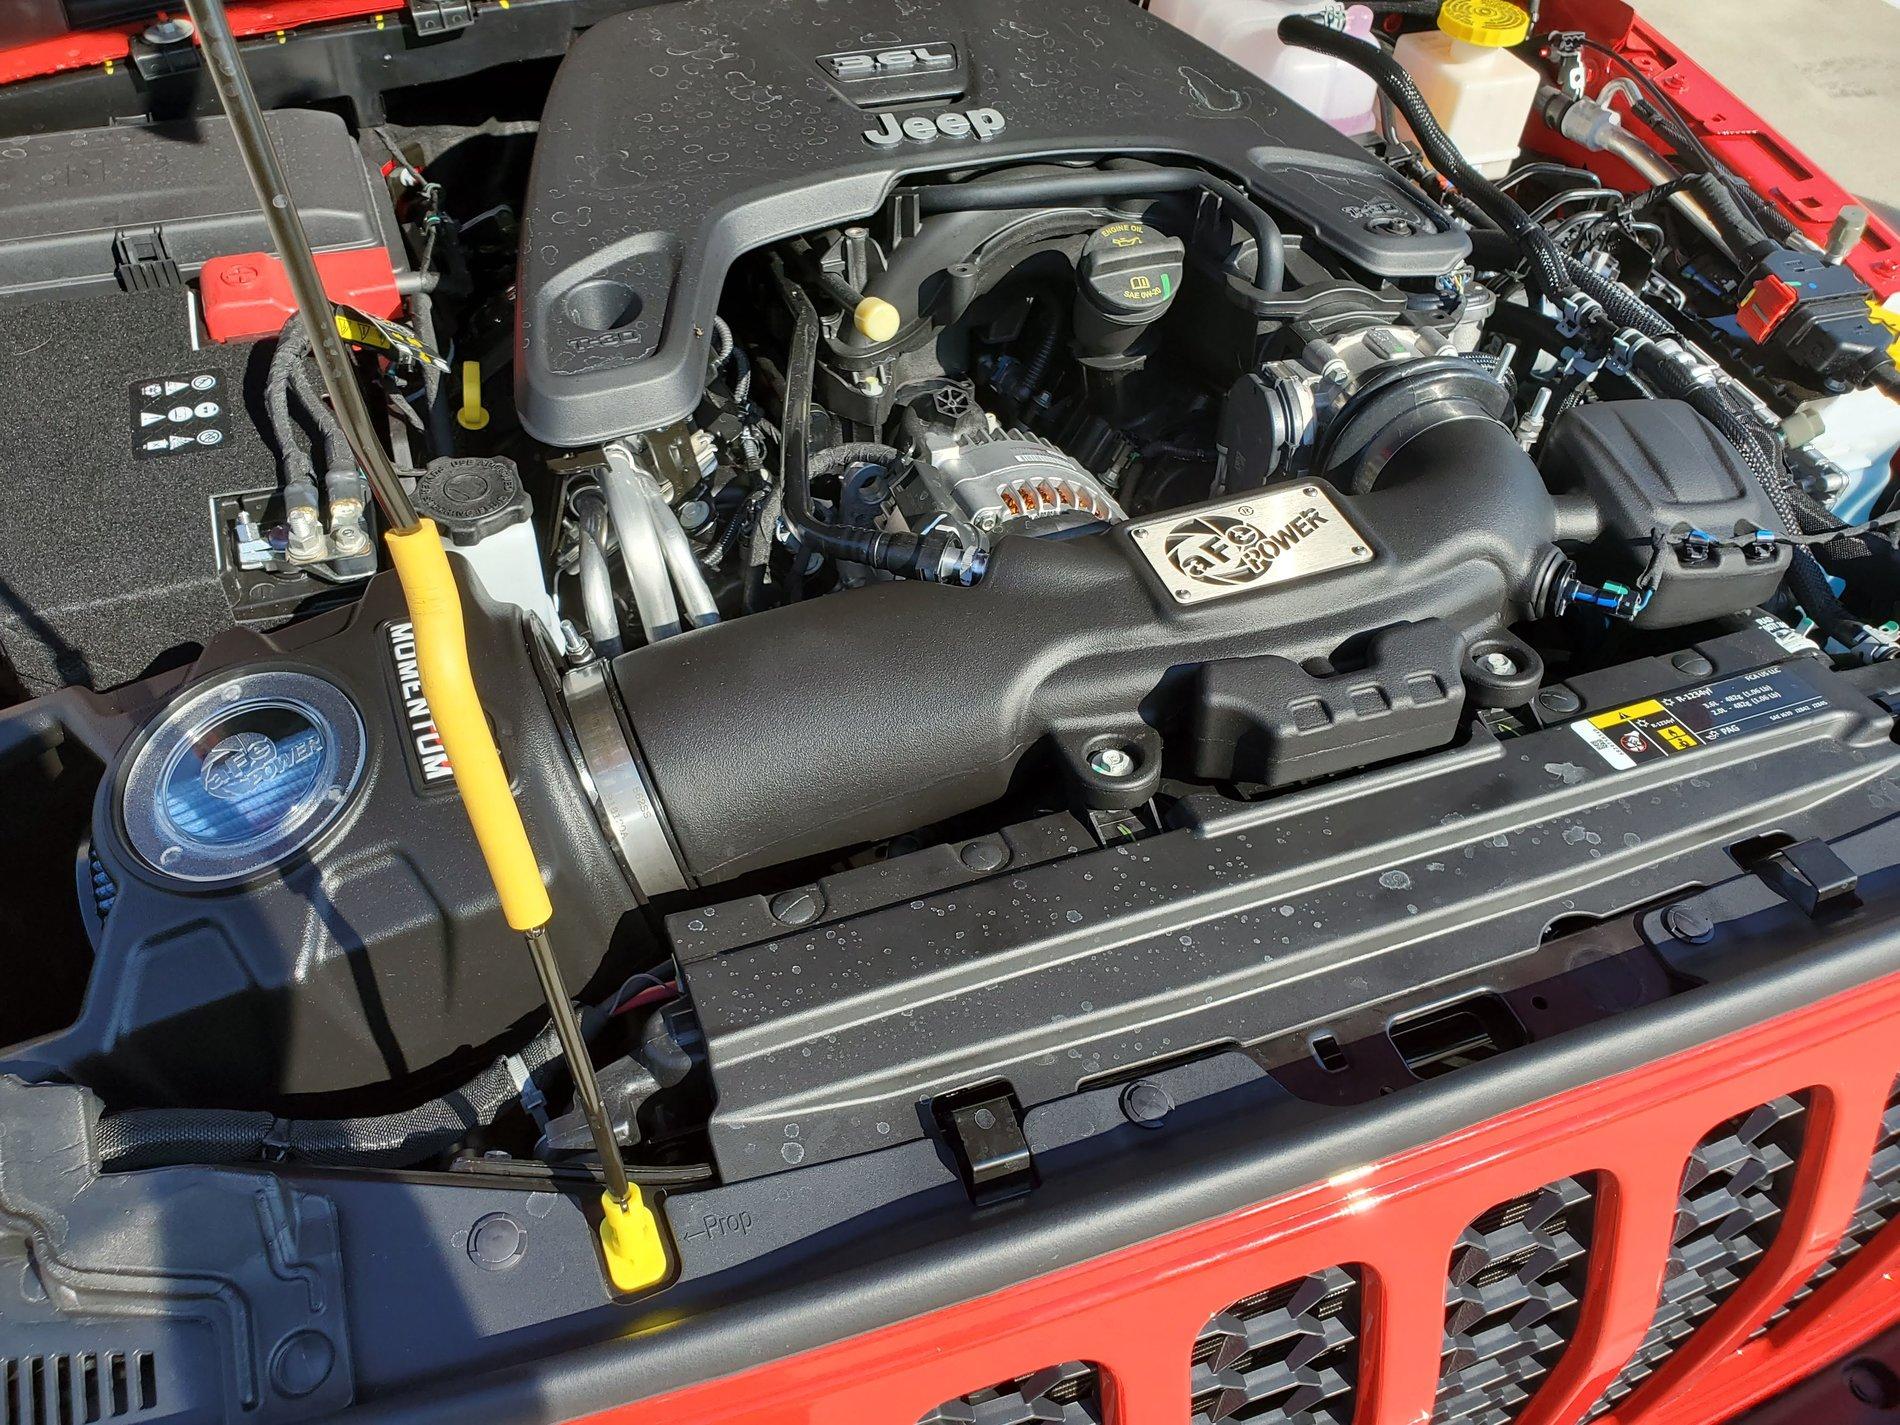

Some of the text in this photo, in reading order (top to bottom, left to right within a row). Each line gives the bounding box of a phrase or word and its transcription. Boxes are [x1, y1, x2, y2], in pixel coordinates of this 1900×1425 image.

[831, 48, 952, 74] 3.6L
[862, 107, 1006, 149] Jeep
[1101, 224, 1143, 238] ENGINE OIL
[1123, 287, 1161, 299] SAE 0W-20
[1242, 507, 1329, 574] POWER
[1744, 673, 1760, 682] FCA
[1769, 667, 1782, 675] LLC
[390, 622, 454, 780] MOMENTUM
[1675, 687, 1713, 703] R-1234yf
[1720, 724, 1740, 736] PAG
[703, 1211, 752, 1239] Prop
